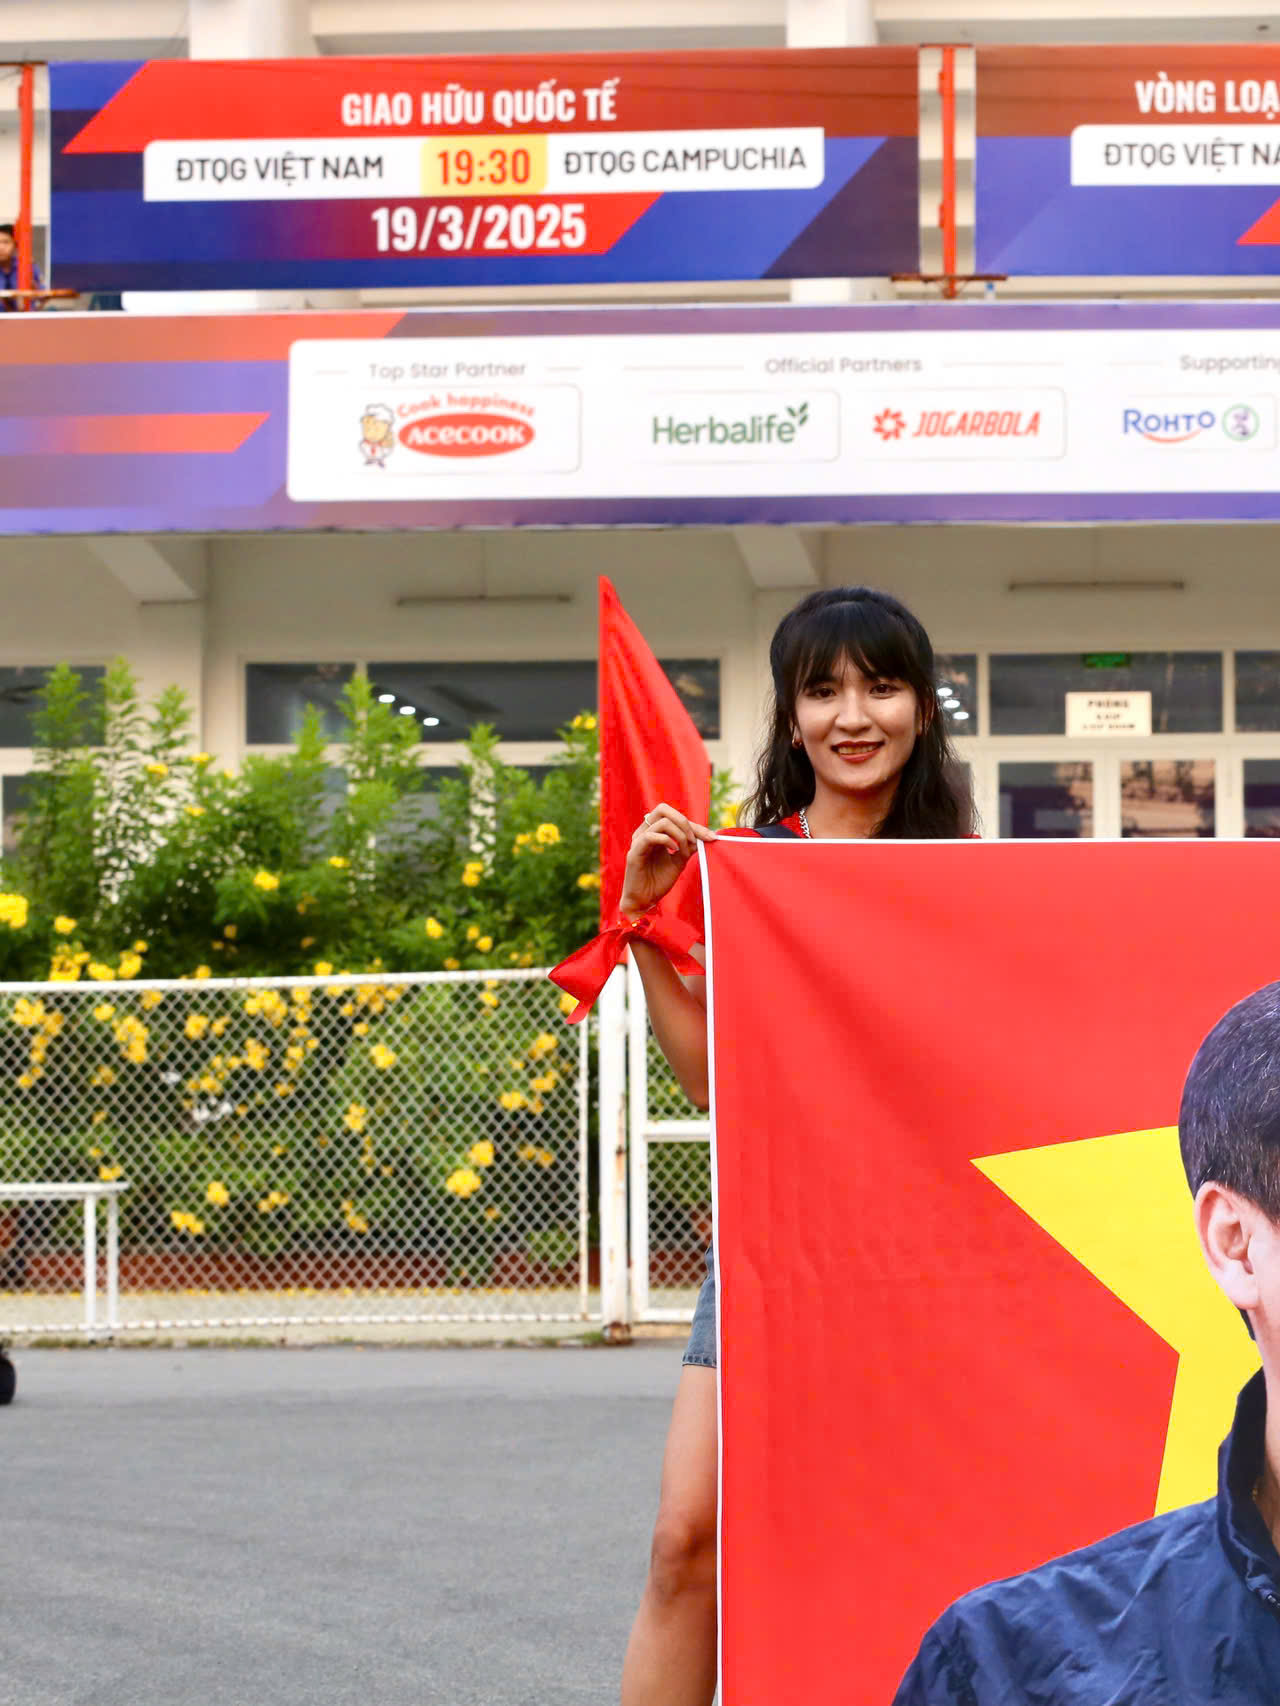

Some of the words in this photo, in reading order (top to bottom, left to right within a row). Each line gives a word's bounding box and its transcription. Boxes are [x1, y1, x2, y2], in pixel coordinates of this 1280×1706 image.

[341, 93, 412, 126] GIAO
[421, 83, 484, 124] HỮU
[492, 79, 576, 128] QUỐC
[583, 77, 620, 121] TẾ
[1135, 71, 1216, 113] VÒNG
[176, 157, 246, 183] ĐTQG
[254, 151, 314, 187] VIỆT
[322, 155, 383, 179] NAM
[437, 149, 531, 186] 19:30
[564, 151, 635, 175] ĐTQG
[643, 147, 807, 172] CAMPUCHIA
[1104, 143, 1175, 168] ĐTQG
[1183, 137, 1244, 173] VIỆT
[371, 203, 586, 252] 19/3/2025
[369, 363, 404, 382] Top
[410, 362, 449, 379] Star
[456, 361, 526, 378] Partner
[765, 357, 834, 374] Official
[840, 357, 922, 373] Partners
[651, 413, 797, 444] Herbalife
[912, 410, 1041, 438] JOGARBOLA
